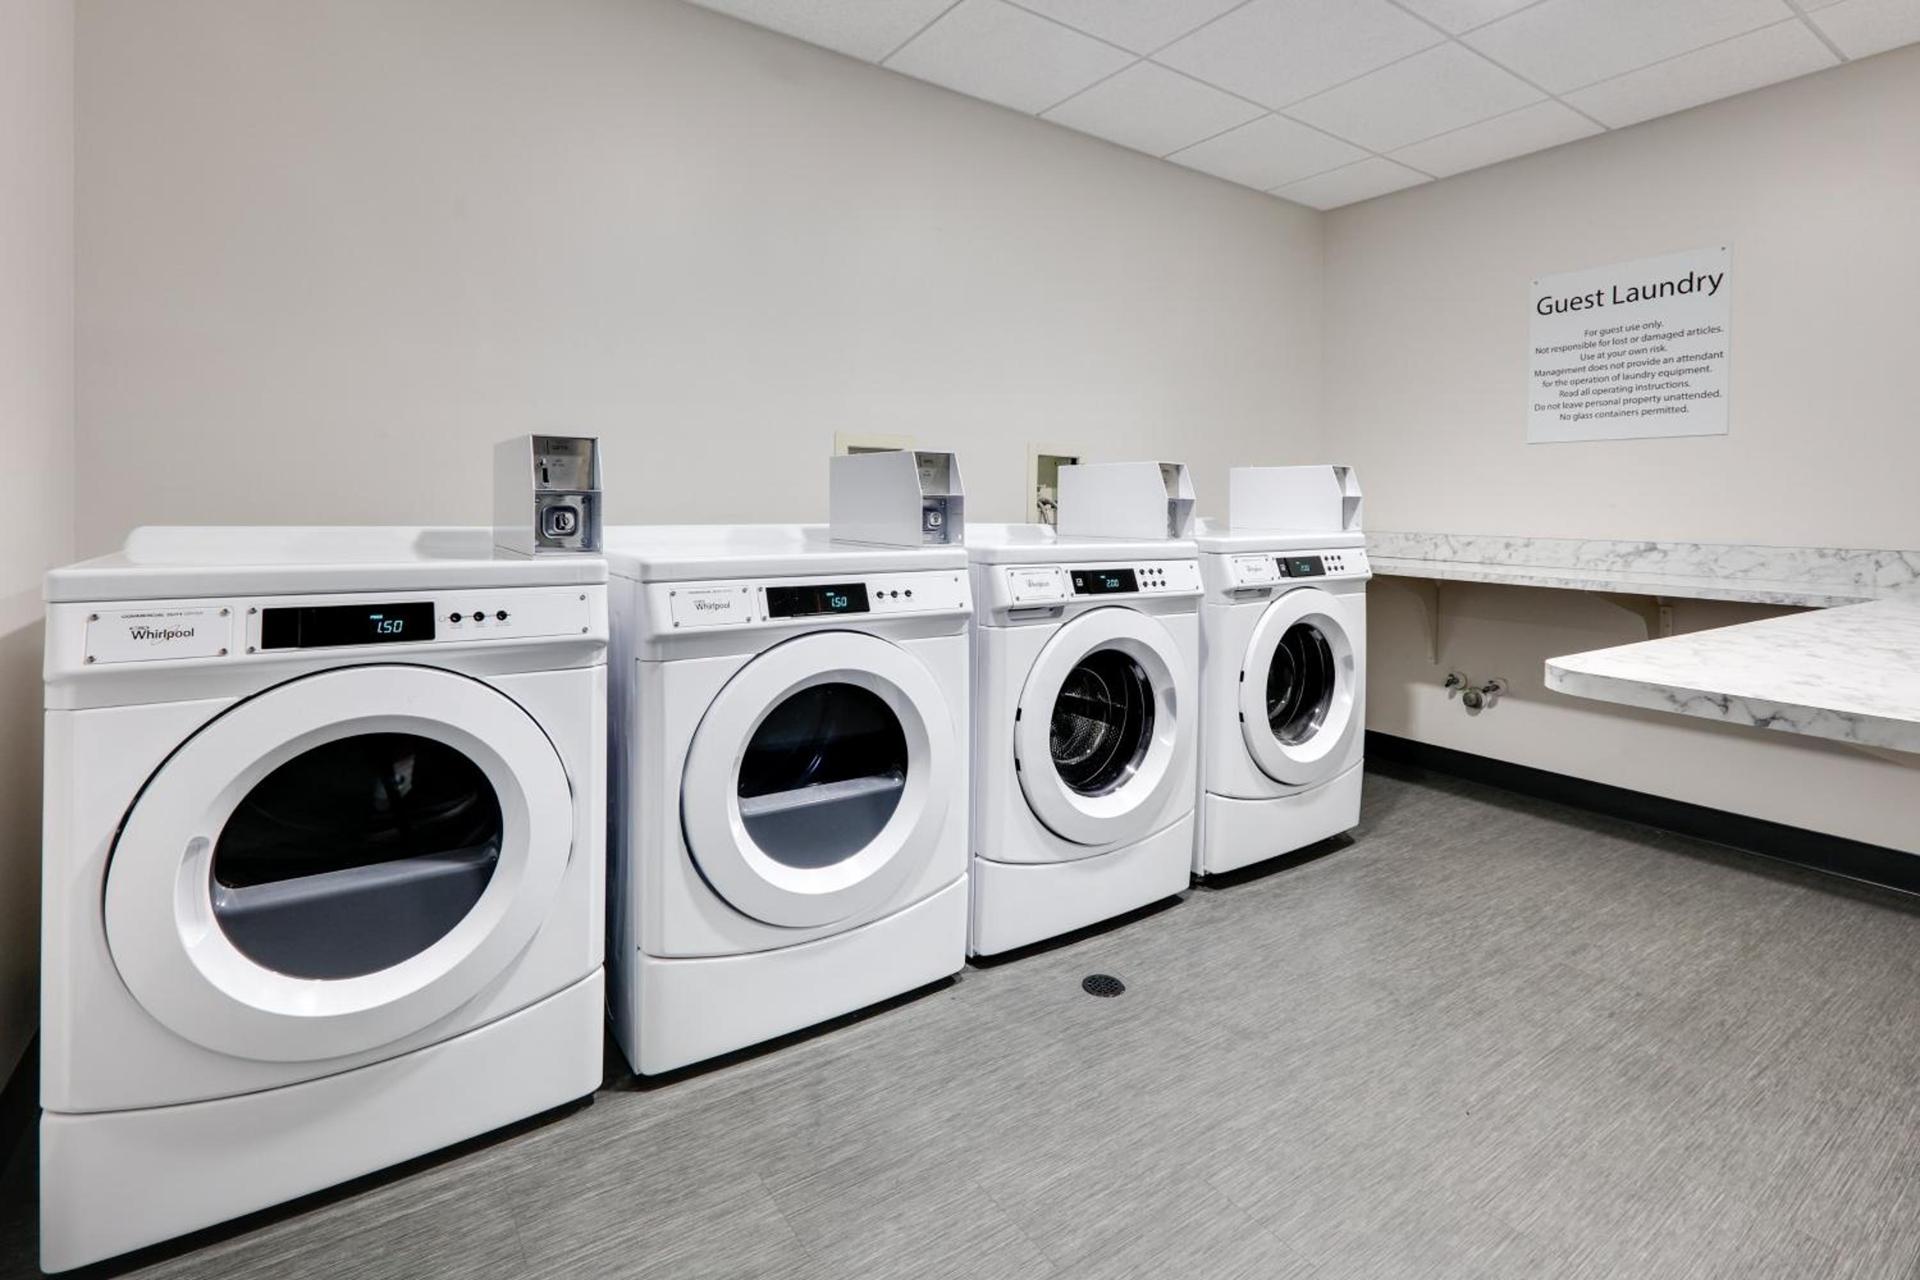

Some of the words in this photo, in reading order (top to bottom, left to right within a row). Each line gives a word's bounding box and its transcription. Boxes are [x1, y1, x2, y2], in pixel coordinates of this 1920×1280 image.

[1536, 290, 1605, 316] Guest
[1612, 271, 1724, 305] Laundry
[1584, 328, 1598, 337] For
[1599, 326, 1624, 337] guest
[1625, 324, 1640, 332] use
[1642, 320, 1664, 330] only.
[1536, 346, 1550, 355] Not
[1551, 340, 1597, 353] responsible
[1598, 339, 1610, 347] for
[1612, 337, 1628, 346] lost
[1630, 335, 1639, 344] or
[1641, 330, 1684, 342] damaged
[1687, 326, 1724, 336] articles.
[1580, 353, 1596, 361] Use
[1607, 350, 1627, 360] your
[1628, 347, 1648, 356] own
[1650, 344, 1668, 353] risk.
[1534, 365, 1586, 377] Management
[1588, 364, 1608, 372] does
[1610, 361, 1624, 370] not
[1626, 357, 1661, 370] provide
[1662, 356, 1674, 364] an
[1676, 351, 1724, 363] attendant
[1542, 379, 1554, 388] for
[1554, 378, 1568, 386] the
[1570, 374, 1610, 386] operation
[1611, 372, 1620, 381] of
[1622, 370, 1656, 380] laundry
[1658, 365, 1712, 377] equipment.
[1560, 388, 1579, 398] Read
[1580, 387, 1591, 396] all
[1592, 384, 1634, 396] operating
[1635, 380, 1690, 392] instructions.
[1534, 403, 1546, 412] Do
[1546, 402, 1561, 410] not
[1562, 400, 1584, 409] leave
[1585, 398, 1621, 408] personal
[1622, 394, 1660, 406] property
[1663, 390, 1722, 402] unattended.
[1560, 413, 1572, 422] No
[1572, 411, 1593, 422] glass
[1595, 408, 1639, 418] containers
[1641, 404, 1689, 416] permitted.
[694, 600, 730, 610] Whirlpool
[130, 627, 194, 640] Whirlpool
